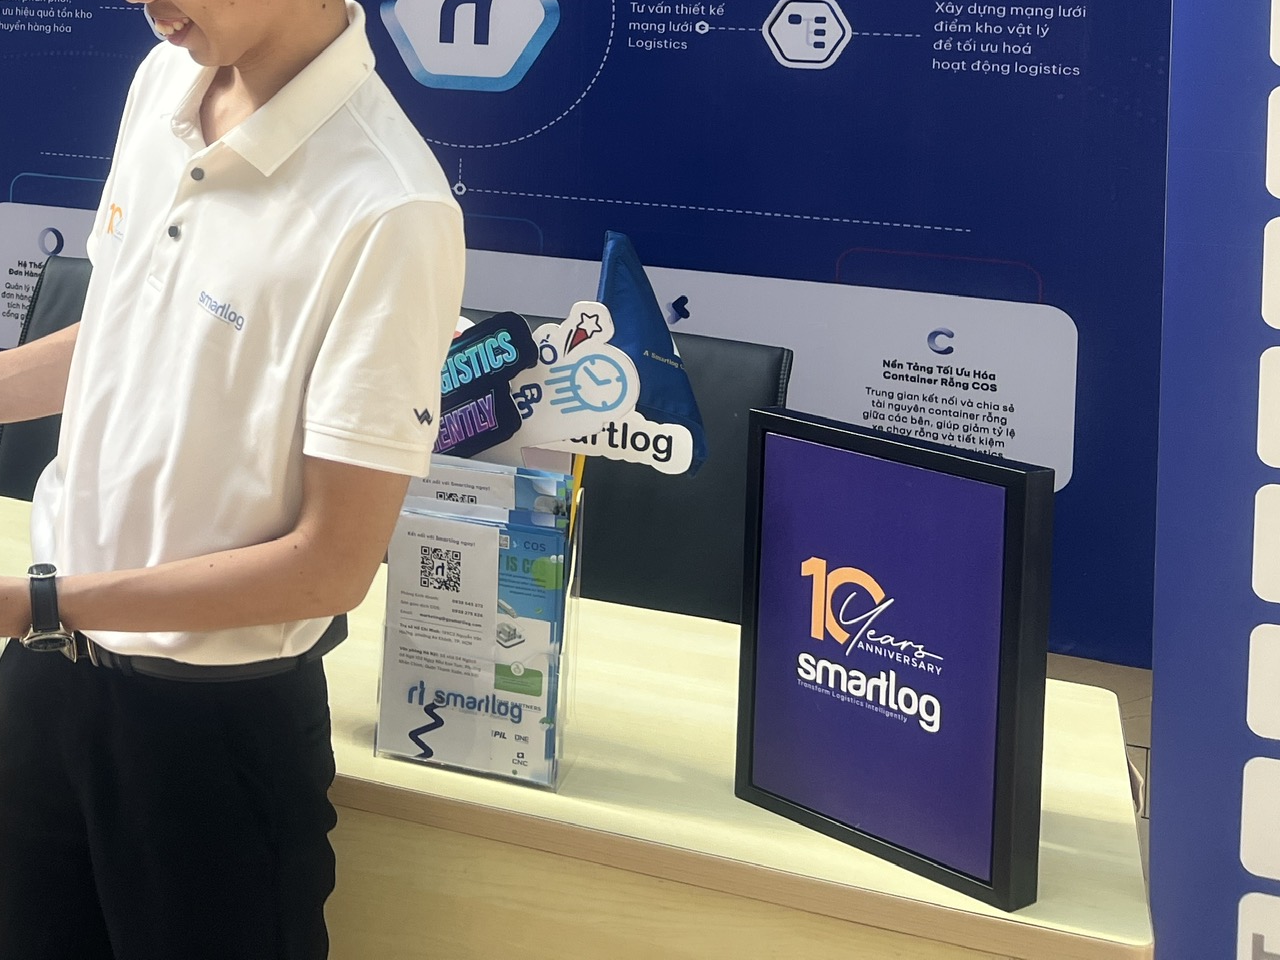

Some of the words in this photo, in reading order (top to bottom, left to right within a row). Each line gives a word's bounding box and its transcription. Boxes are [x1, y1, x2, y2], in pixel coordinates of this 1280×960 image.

[630, 2, 646, 13] Tư
[675, 2, 705, 15] thiết
[935, 1, 963, 16] Xây
[1010, 7, 1054, 19] mạng
[628, 37, 687, 50] Logistics
[629, 22, 665, 34] mạng
[976, 22, 1002, 34] kho
[1037, 24, 1049, 38] lý
[198, 290, 245, 331] smartlog
[440, 331, 517, 394] GISTICS
[883, 371, 938, 385] Container
[972, 382, 997, 392] COS
[801, 557, 885, 645] 10
[839, 591, 944, 656] Years
[857, 641, 942, 675] ANNIVERSARY
[797, 652, 942, 732] smartlog
[797, 679, 830, 695] Transform
[832, 691, 863, 706] Logistics
[866, 703, 907, 723] Intelligently
